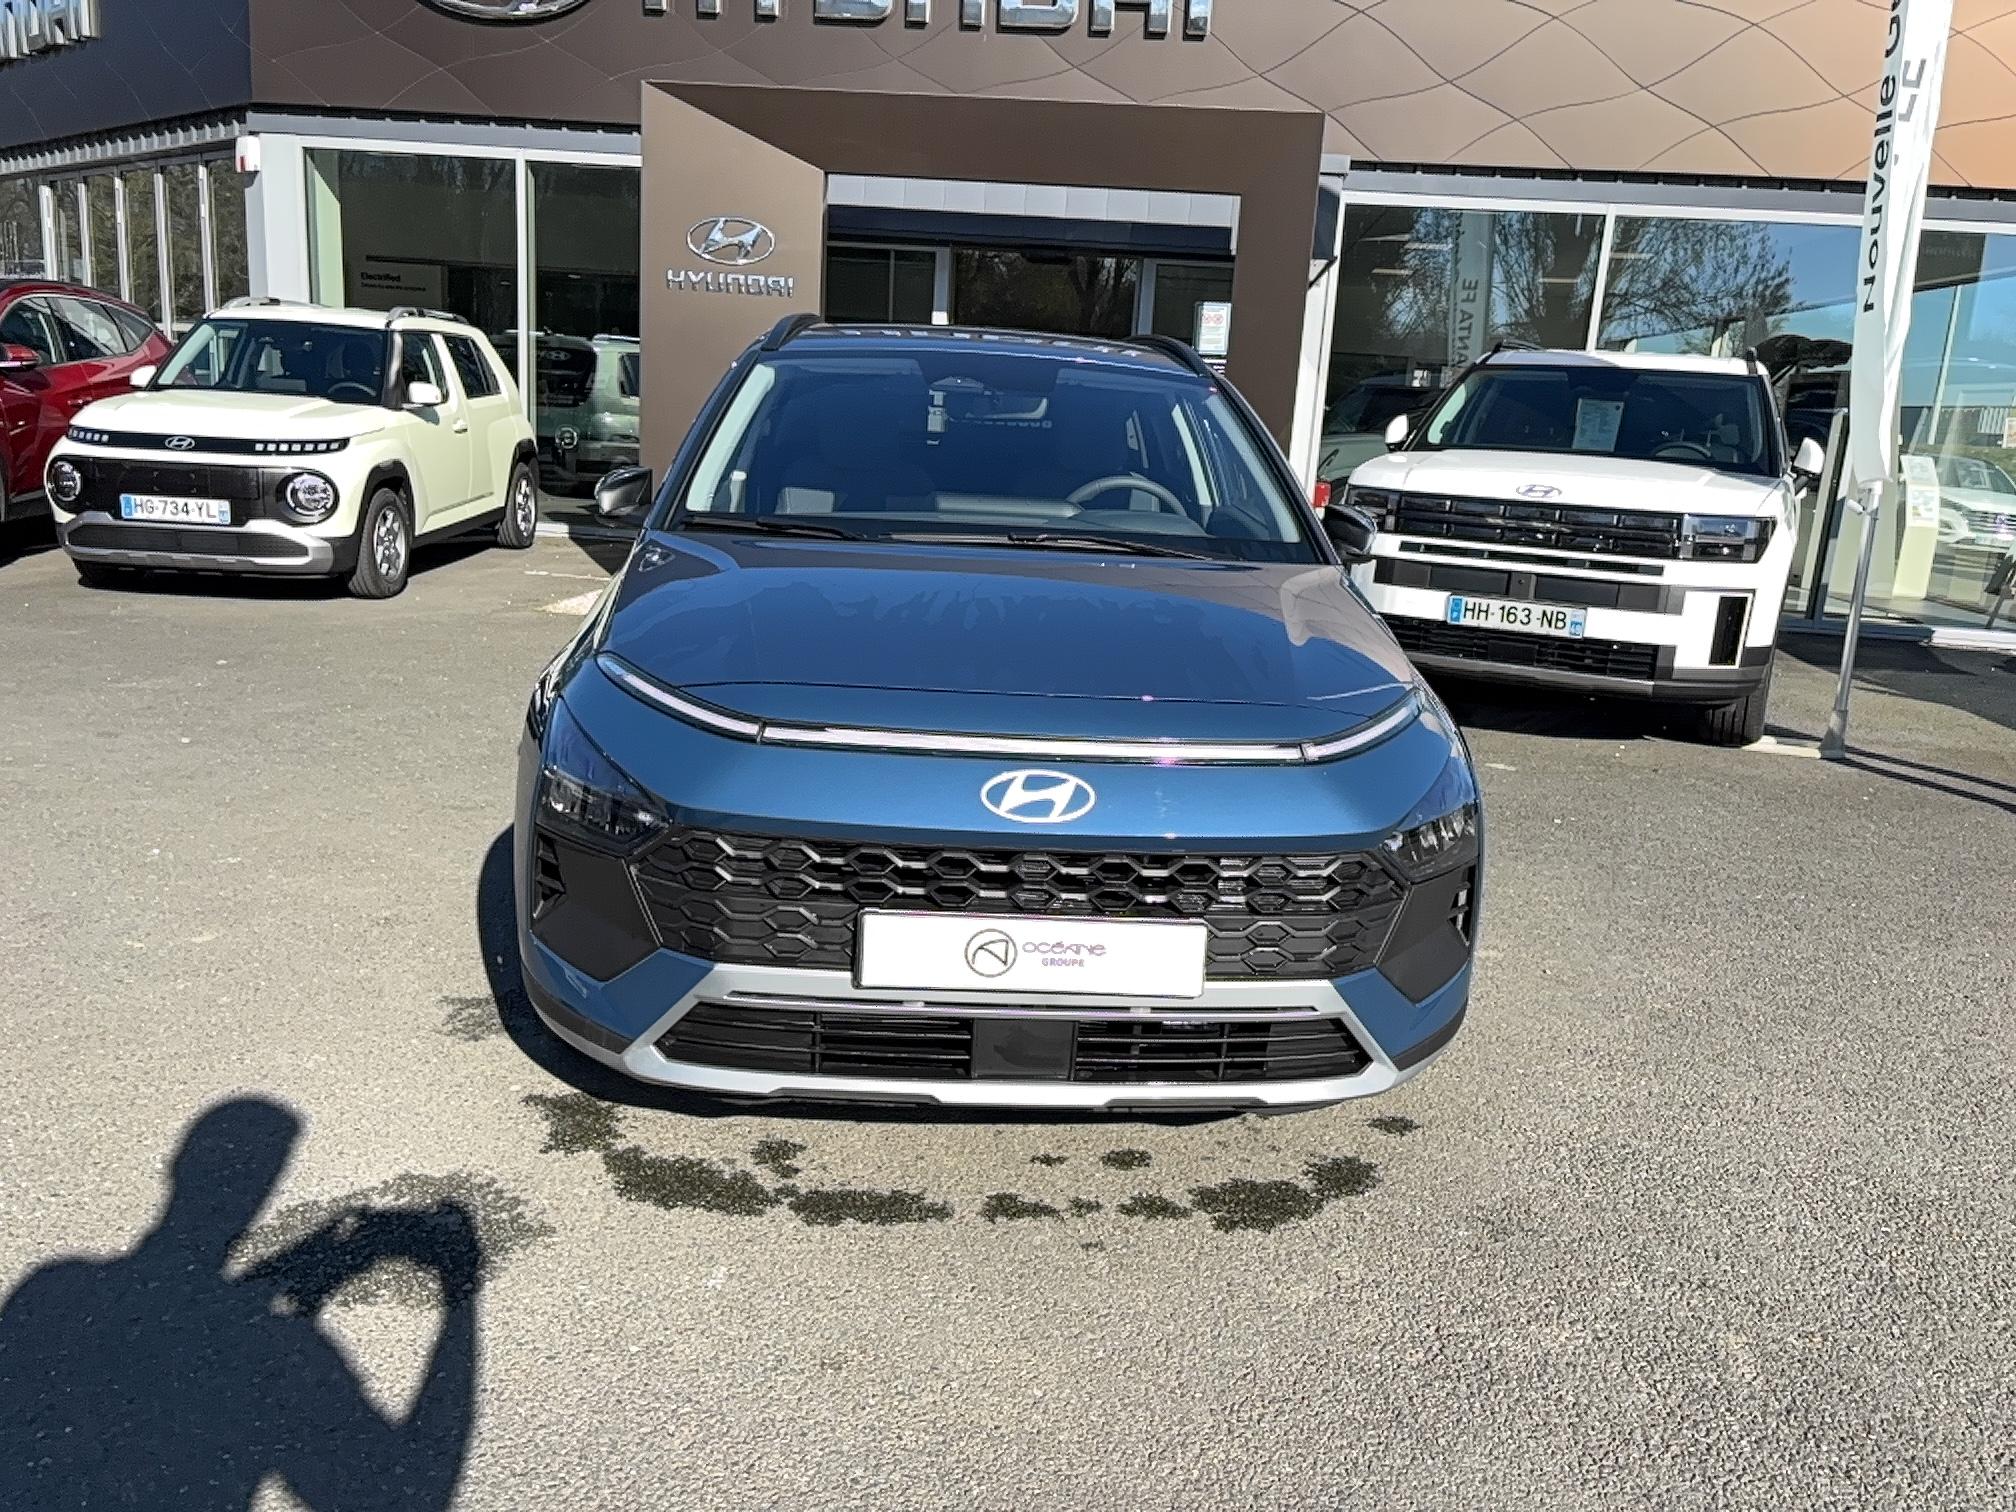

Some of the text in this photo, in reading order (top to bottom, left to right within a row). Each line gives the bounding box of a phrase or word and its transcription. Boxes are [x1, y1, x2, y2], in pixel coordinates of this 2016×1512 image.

[1863, 75, 1896, 313] Nouvelle
[666, 268, 794, 298] HYUNDAI
[133, 497, 217, 519] HG-734-YL
[1463, 600, 1567, 630] HH-163-NB
[1041, 957, 1085, 967] GROUPE
